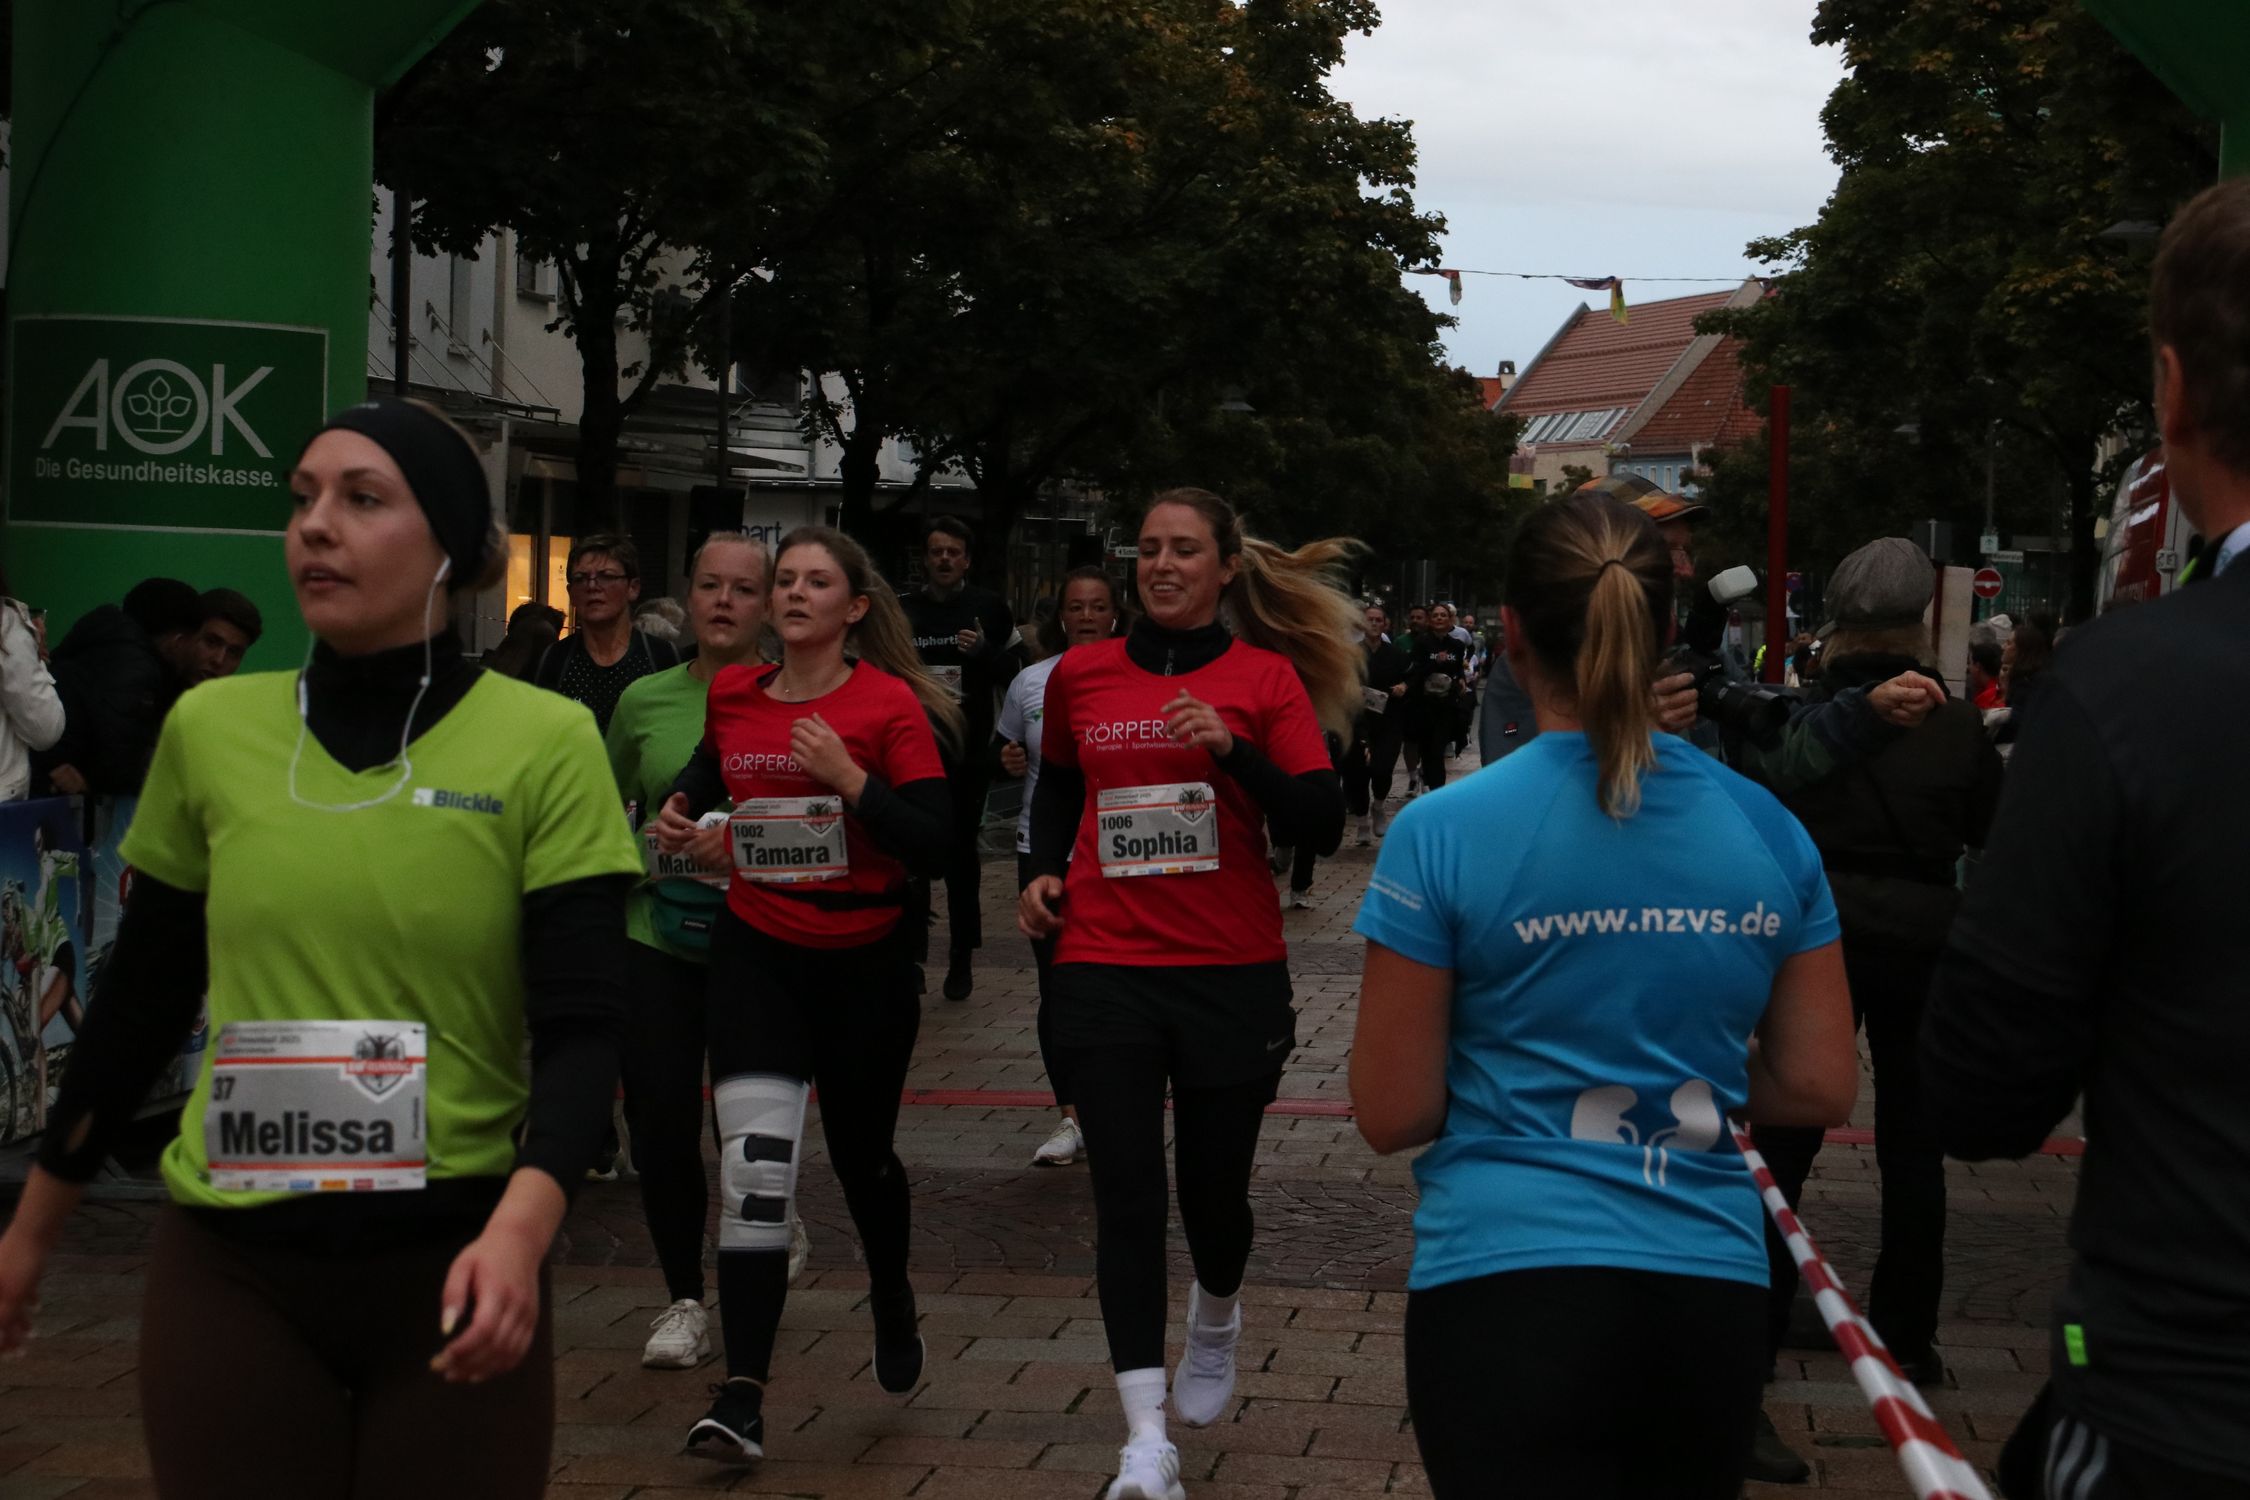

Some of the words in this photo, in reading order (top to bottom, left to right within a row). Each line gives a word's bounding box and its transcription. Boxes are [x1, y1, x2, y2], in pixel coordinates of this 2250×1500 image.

[41, 358, 275, 459] AOK
[35, 457, 61, 478] Die
[66, 457, 279, 488] Gesundheitskasse.
[434, 789, 504, 815] Blickle
[734, 825, 764, 839] 1002
[1101, 815, 1133, 830] 1006
[742, 843, 830, 866] Tamara
[1113, 831, 1198, 861] Sophia
[1513, 900, 1781, 944] www.nzvs.de
[214, 1076, 235, 1101] 37
[220, 1111, 395, 1155] Melissa
